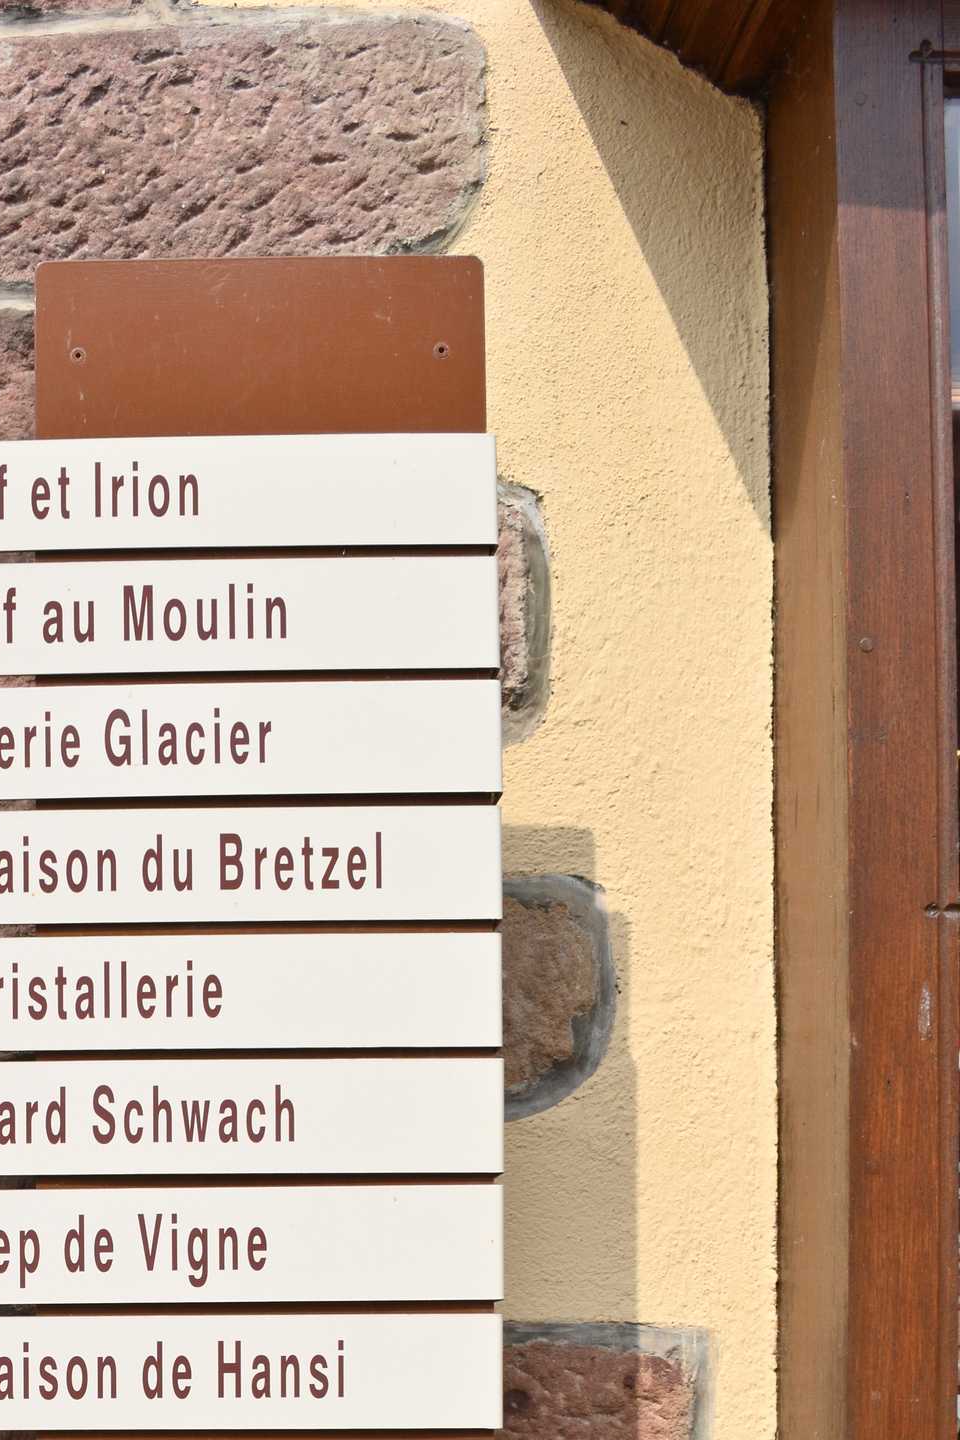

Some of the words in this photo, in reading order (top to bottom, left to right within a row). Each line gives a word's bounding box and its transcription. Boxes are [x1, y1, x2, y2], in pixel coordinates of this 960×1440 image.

[31, 466, 70, 520] et
[94, 461, 199, 518] Irion
[42, 600, 95, 644] au
[123, 583, 287, 642] Moulin
[104, 707, 272, 767] Glacier
[142, 833, 193, 893] du
[219, 831, 382, 891] Bretzel
[92, 1084, 295, 1145] Schwach
[64, 1214, 114, 1273] de
[137, 1213, 268, 1288] Vigne
[142, 1340, 192, 1400] de
[217, 1339, 345, 1399] Hansi
